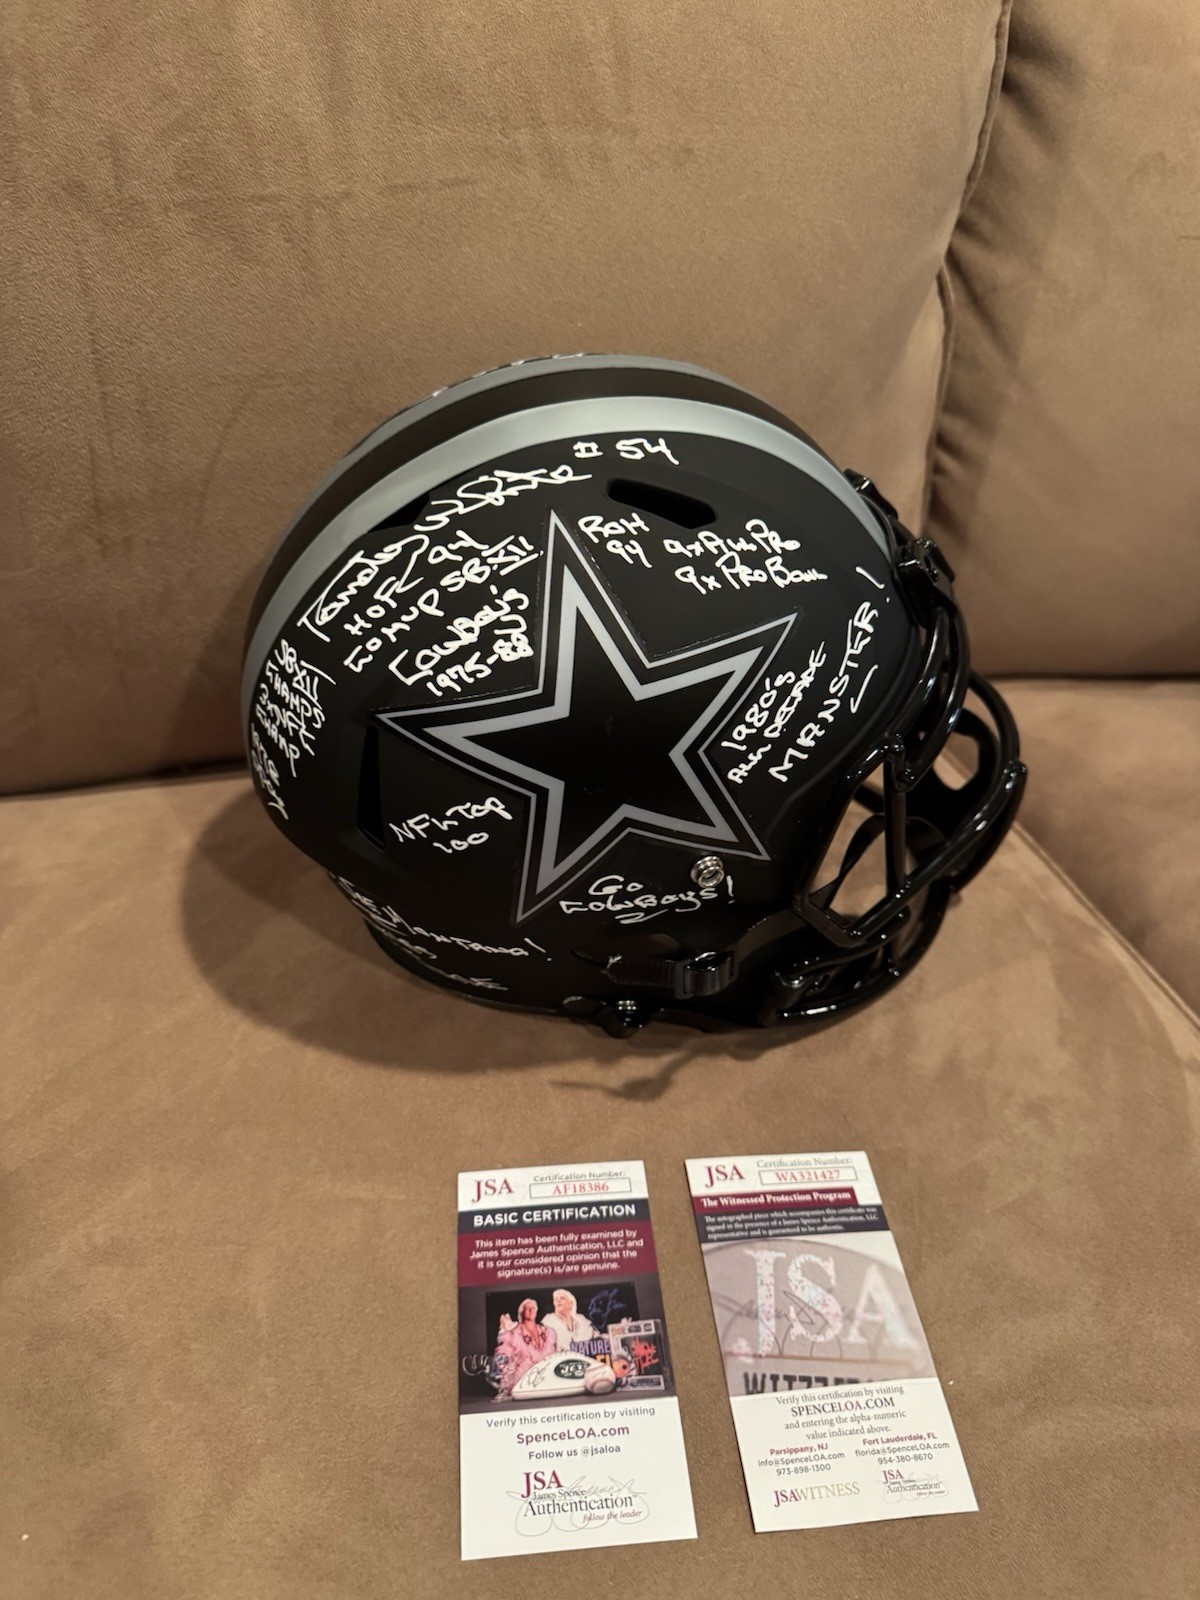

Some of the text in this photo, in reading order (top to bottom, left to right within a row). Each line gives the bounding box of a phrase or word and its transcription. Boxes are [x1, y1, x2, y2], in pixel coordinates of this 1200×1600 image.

[616, 438, 680, 466] 54
[757, 1156, 852, 1169] Certification Number:
[534, 1170, 626, 1182] Certification Number:
[705, 1164, 745, 1187] JSA
[775, 1170, 840, 1182] WA321427
[472, 1178, 514, 1203] JSA
[553, 1182, 609, 1195] AF18386
[702, 1191, 851, 1207] The Witnessed Protection Program
[473, 1204, 635, 1227] BASIC CERTIFICATION
[475, 1229, 637, 1248] This item has been fully examined by
[470, 1250, 499, 1259] James
[501, 1247, 534, 1256] Spence
[607, 1240, 624, 1248] LLC
[627, 1239, 644, 1247] and
[478, 1260, 484, 1269] it
[487, 1259, 494, 1267] is
[514, 1255, 564, 1266] considered
[566, 1251, 600, 1262] opinion
[602, 1250, 620, 1258] that
[623, 1249, 637, 1257] the
[497, 1262, 620, 1278] signature(s) is/are genuine.
[776, 1385, 905, 1405] Verify this certification by visiting
[791, 1398, 895, 1417] SPENCELOA.COM
[486, 1406, 655, 1428] Verify this certification by visiting
[785, 1410, 906, 1429] and entering the alpha-numeric
[517, 1426, 630, 1445] SpenceLOA.com
[806, 1425, 891, 1441] value indicated above.
[863, 1437, 880, 1446] Fort
[882, 1434, 925, 1444] Lauderdale,
[529, 1445, 621, 1460] Follow us @jsaloa
[770, 1445, 814, 1456] Parsippany,
[855, 1442, 949, 1457] florida@SpenceLOA.com
[758, 1452, 845, 1467] info@SpenceLOA.com
[878, 1453, 933, 1465] 954-380-8670
[776, 1463, 831, 1476] 973-898-1300
[882, 1469, 904, 1485] JSA
[521, 1469, 563, 1498] JSA
[531, 1489, 586, 1501] James Spence
[524, 1494, 633, 1517] Authentication
[583, 1510, 642, 1523] follow the leader
